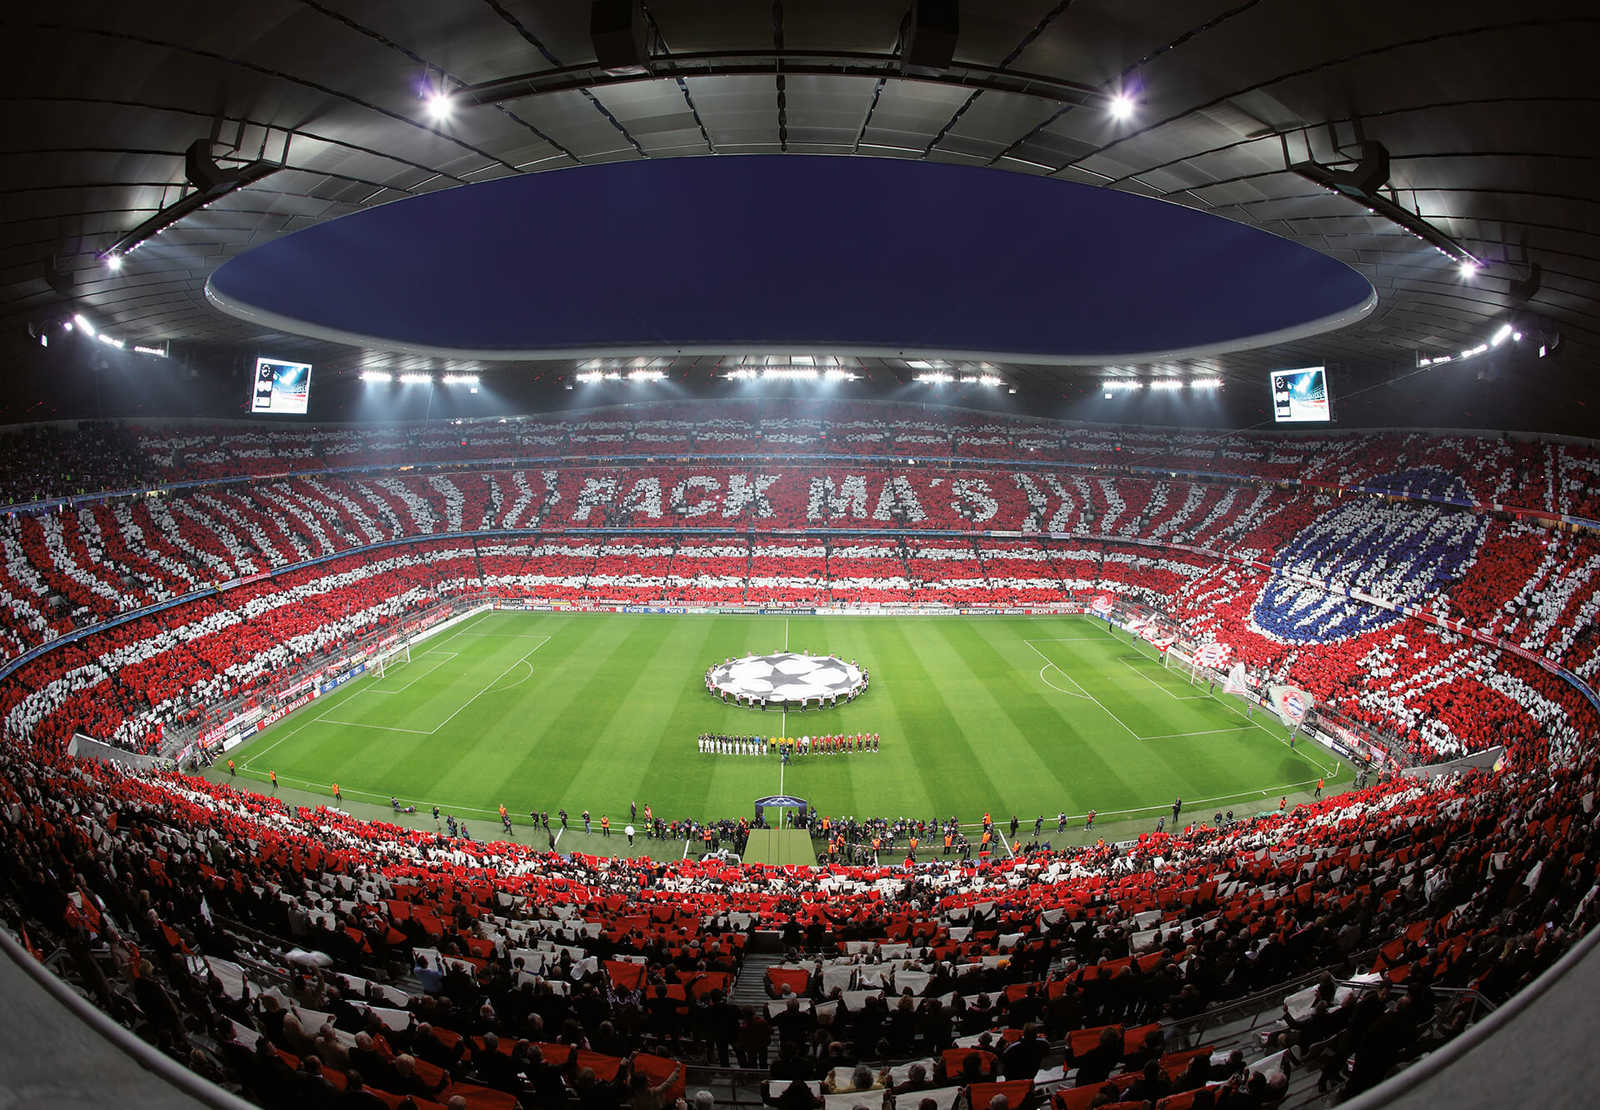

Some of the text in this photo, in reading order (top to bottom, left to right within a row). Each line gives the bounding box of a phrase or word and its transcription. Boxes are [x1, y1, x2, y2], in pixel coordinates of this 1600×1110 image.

[571, 473, 782, 520] PACK
[560, 605, 583, 613] SONY
[336, 671, 351, 685] Ford
[264, 706, 287, 727] SONY
[288, 694, 310, 712] BRAVIA
